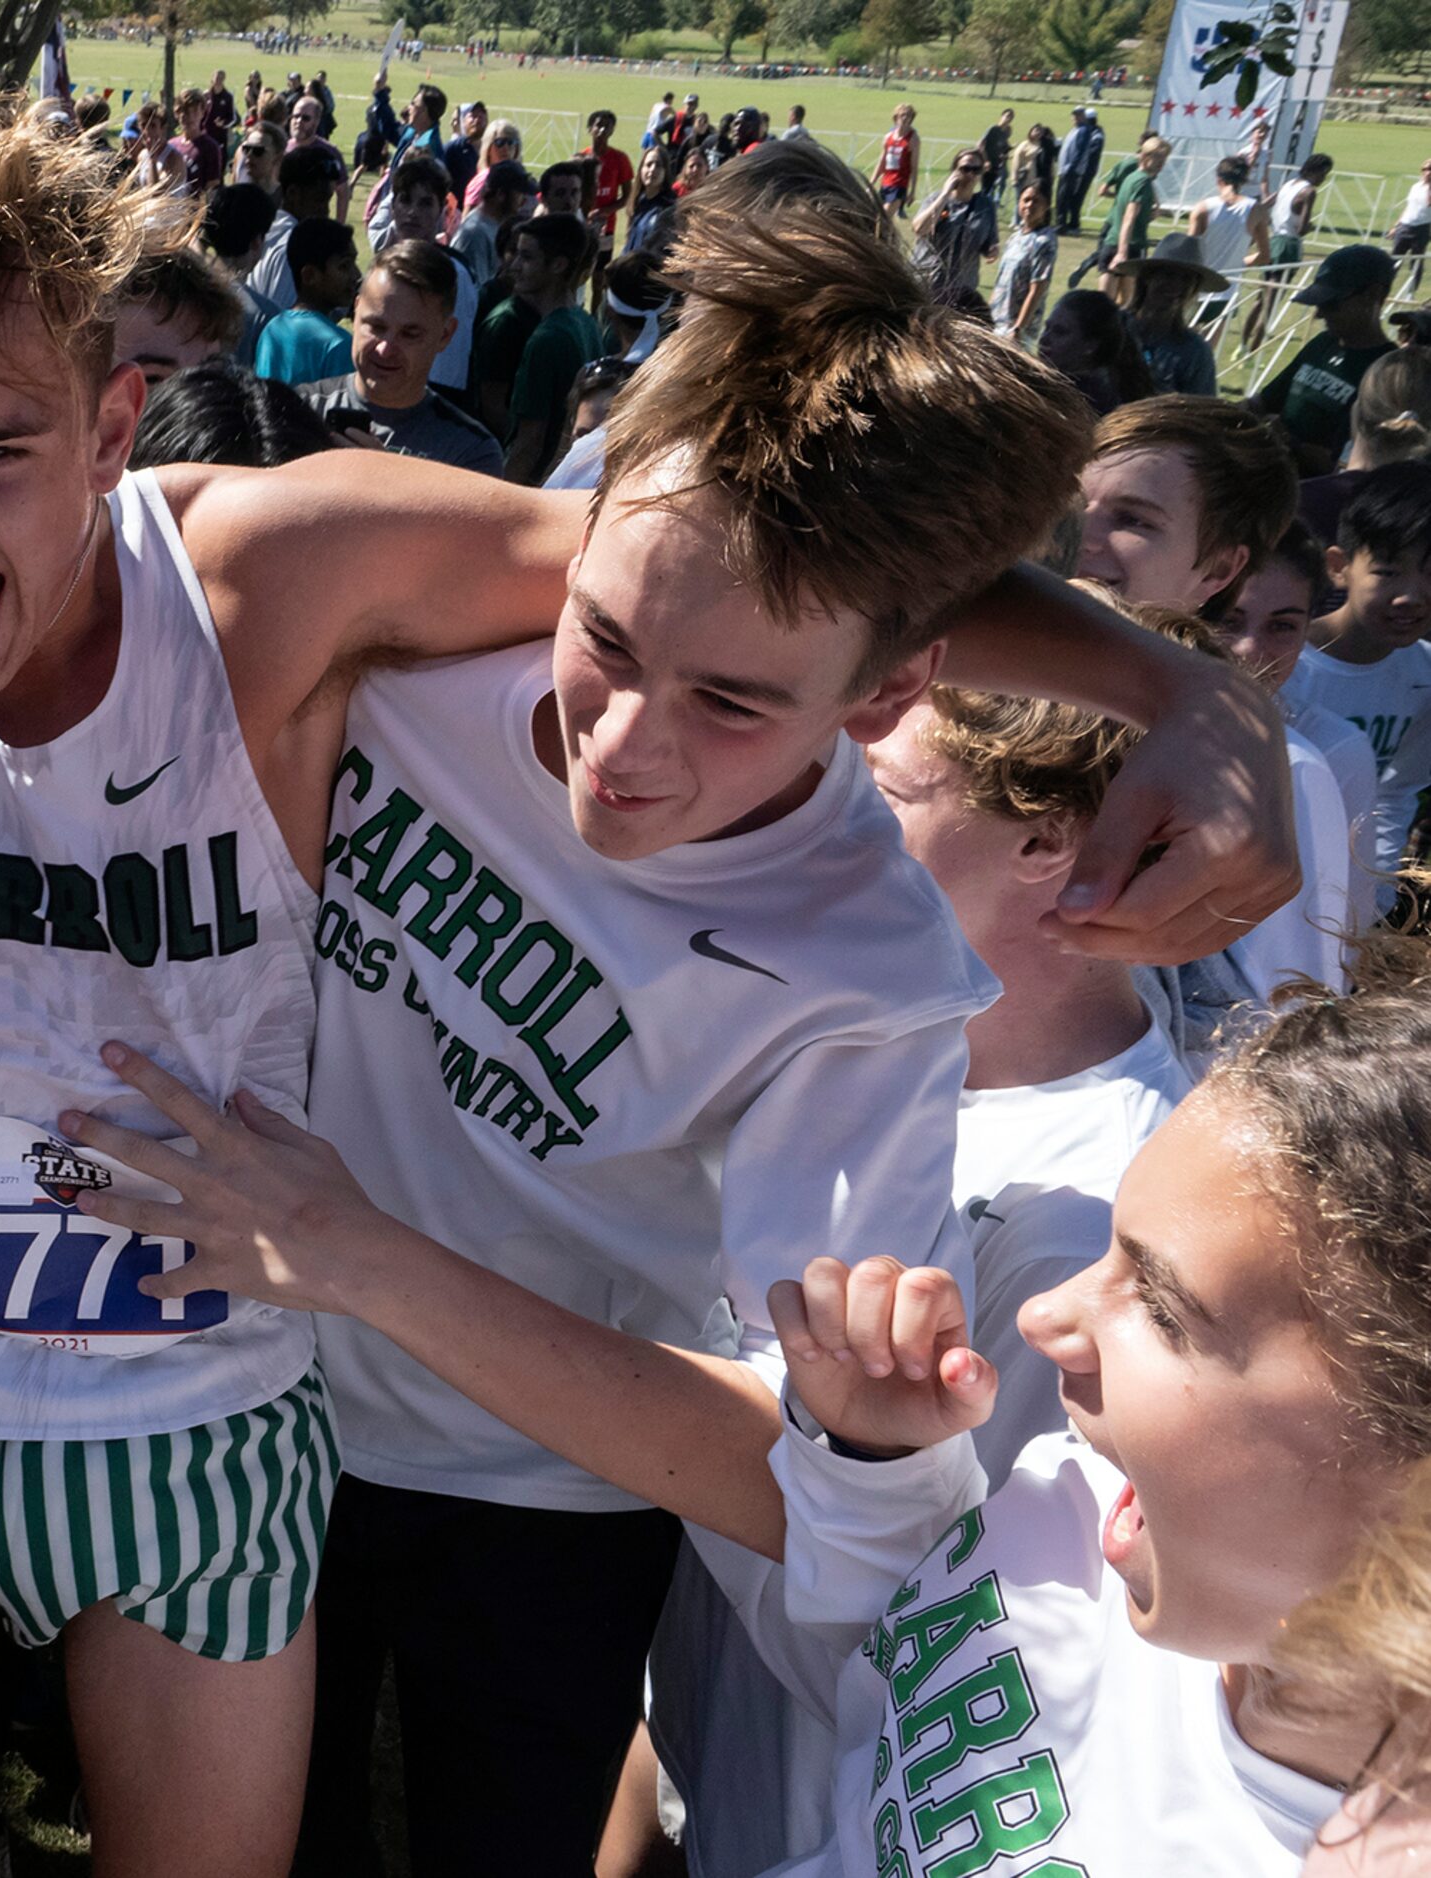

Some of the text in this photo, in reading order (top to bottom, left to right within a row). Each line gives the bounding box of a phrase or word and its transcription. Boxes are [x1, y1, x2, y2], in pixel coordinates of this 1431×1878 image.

[1284, 29, 1326, 176] STAR
[314, 900, 397, 993] OSS
[0, 1176, 20, 1184] 2771
[24, 1155, 110, 1184] STATE
[887, 1506, 1090, 1878] CARR
